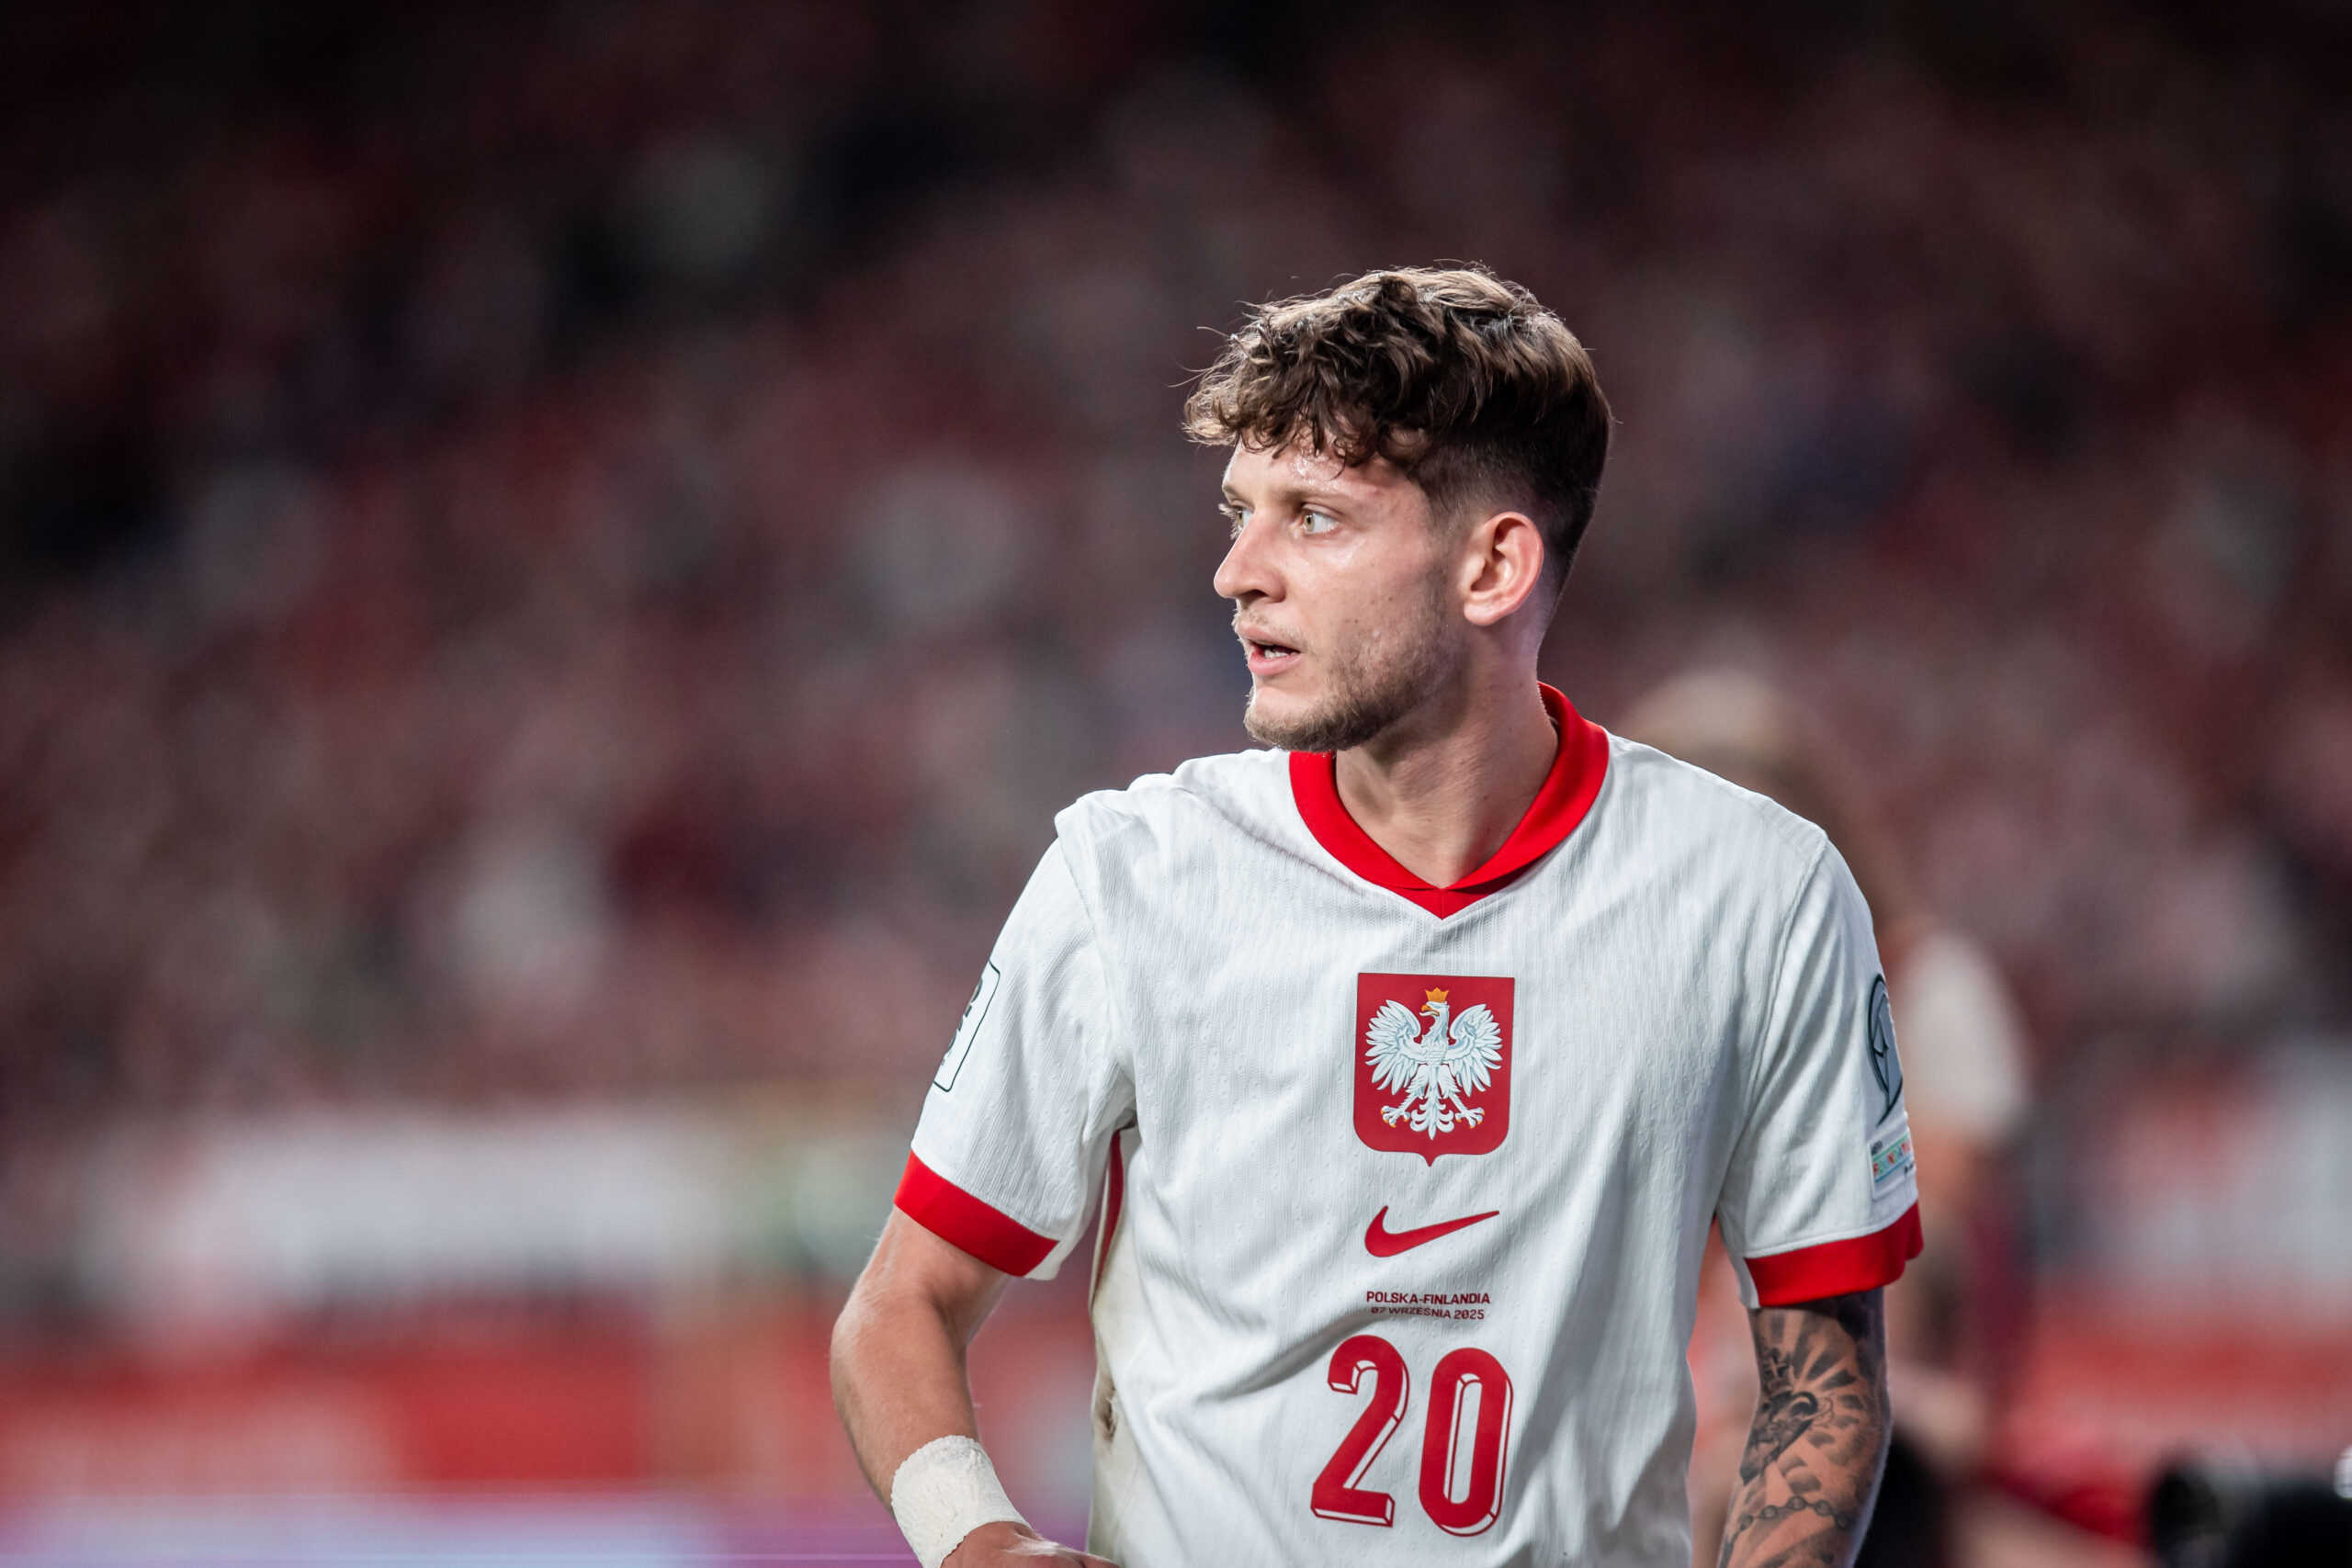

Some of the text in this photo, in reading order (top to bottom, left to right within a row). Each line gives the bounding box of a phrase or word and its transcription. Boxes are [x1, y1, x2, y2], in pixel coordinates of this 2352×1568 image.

[1366, 1291, 1490, 1305] POLSKA-FINLANDIA
[1371, 1306, 1386, 1314] 07
[1453, 1309, 1485, 1320] 2025
[1310, 1334, 1514, 1538] 20
